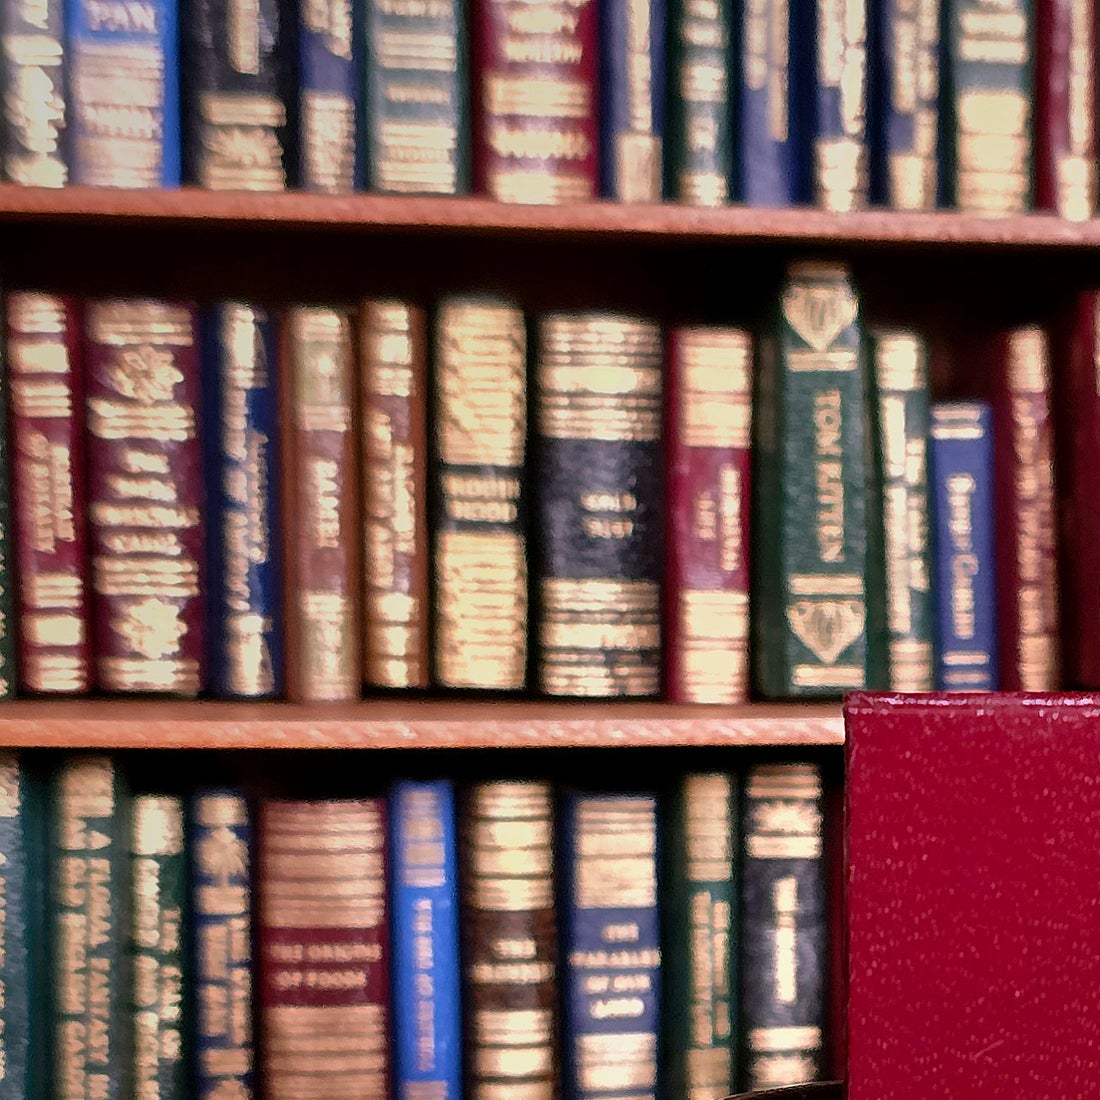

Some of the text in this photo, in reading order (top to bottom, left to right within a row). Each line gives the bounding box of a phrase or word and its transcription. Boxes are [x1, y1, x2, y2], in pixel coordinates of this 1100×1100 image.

[313, 460, 341, 549] BAMBI
[814, 389, 845, 562] TOM KITTEN
